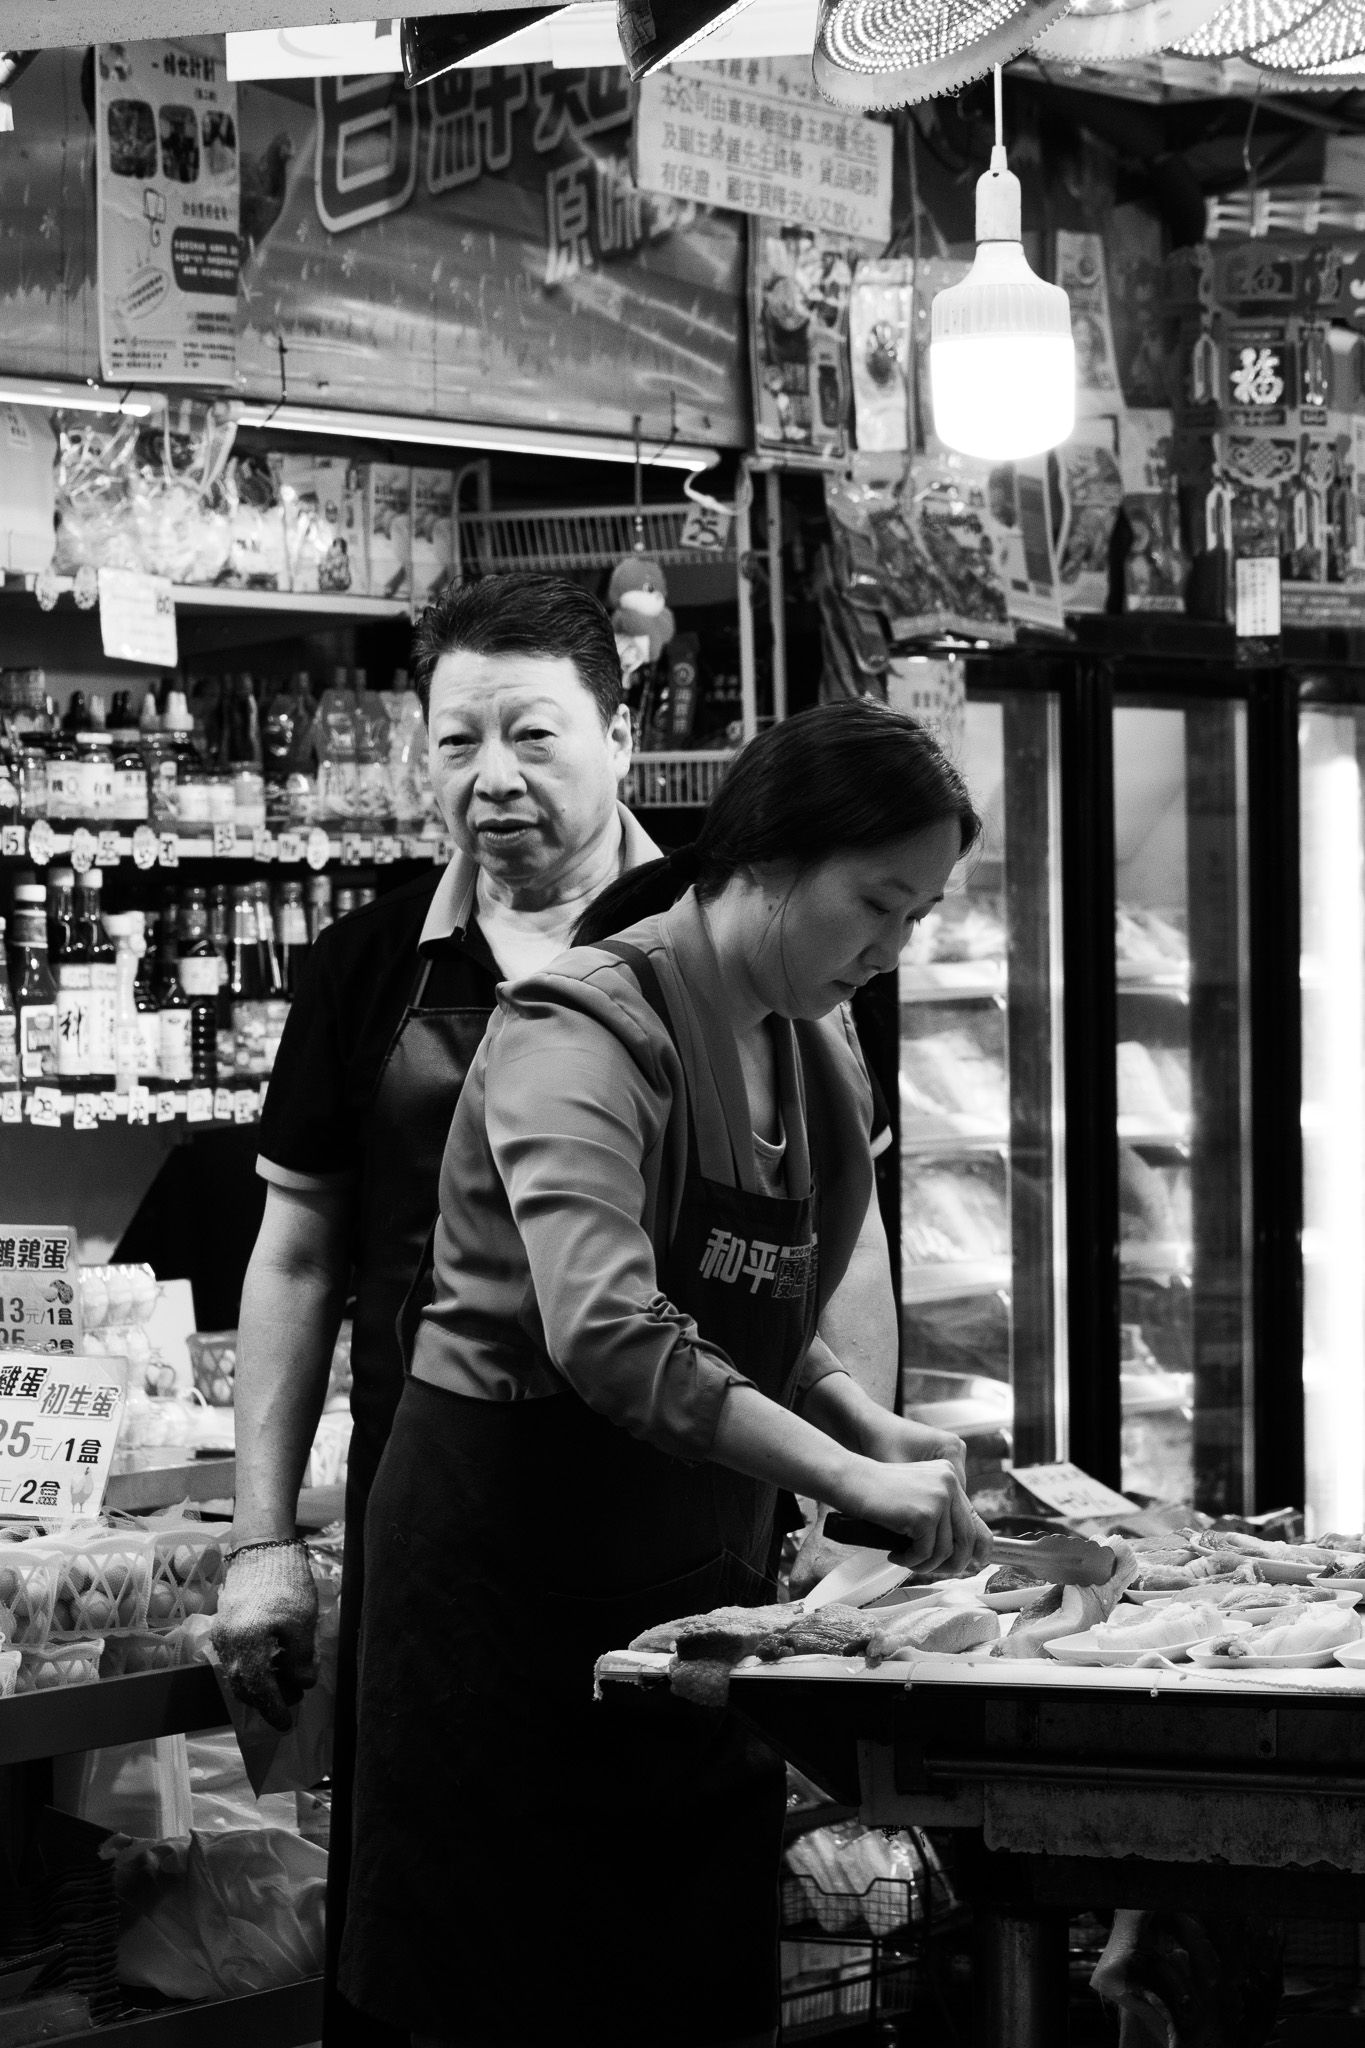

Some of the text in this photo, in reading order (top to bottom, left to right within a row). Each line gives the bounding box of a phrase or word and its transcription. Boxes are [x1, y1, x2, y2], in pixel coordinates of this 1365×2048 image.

[1230, 348, 1285, 405] 福
[699, 1228, 780, 1294] 和平
[40, 1383, 119, 1418] 初生蛋
